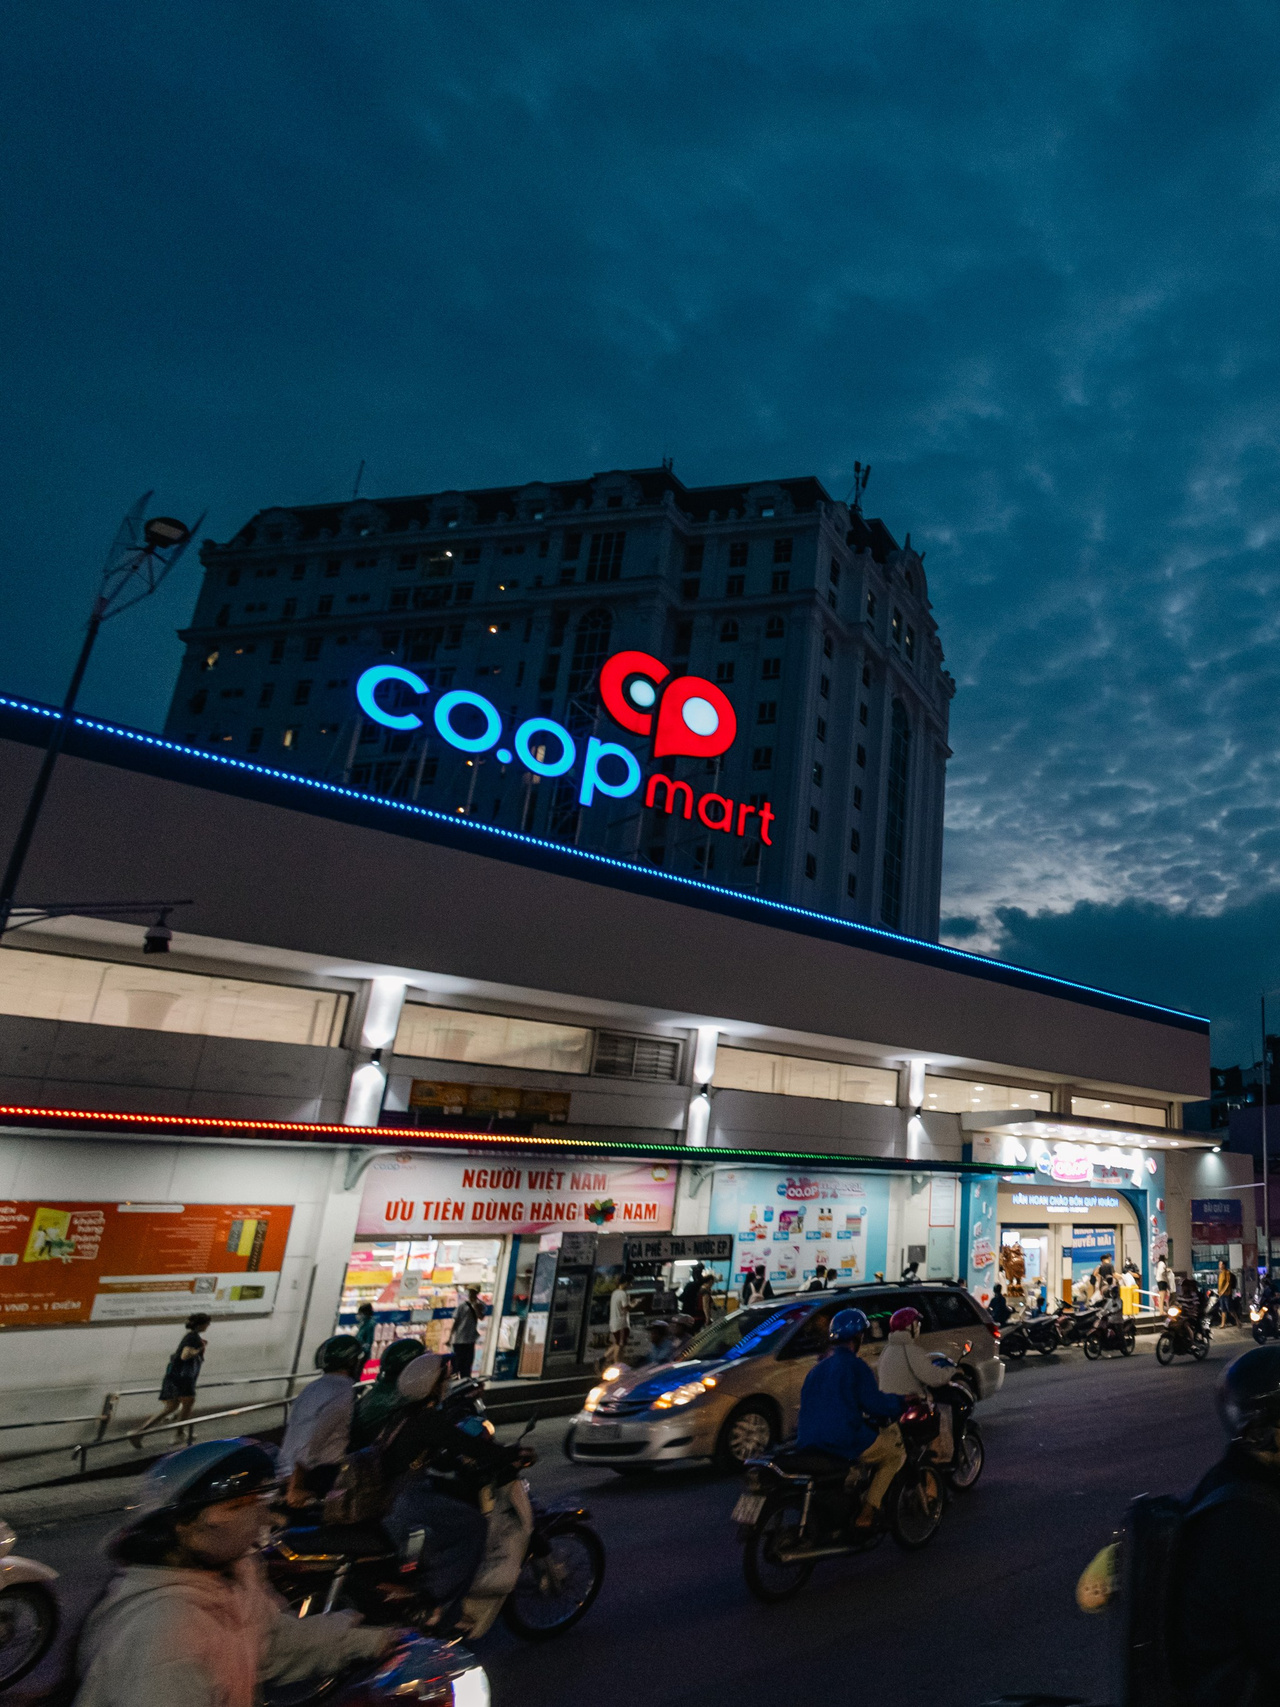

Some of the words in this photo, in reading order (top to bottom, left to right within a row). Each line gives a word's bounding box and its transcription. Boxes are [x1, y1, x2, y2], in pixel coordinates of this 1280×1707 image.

[356, 664, 641, 807] co.op
[645, 773, 776, 847] mart
[462, 1165, 521, 1189] NGƯỜI
[528, 1167, 565, 1194] VIỆT
[570, 1172, 607, 1191] NAM
[423, 1198, 465, 1221] TIÊN
[472, 1198, 524, 1221] DÙNG
[529, 1199, 577, 1221] HÀNG
[623, 1203, 657, 1221] NAM
[631, 1240, 642, 1258] CÀ
[645, 1240, 662, 1257] PHÊ
